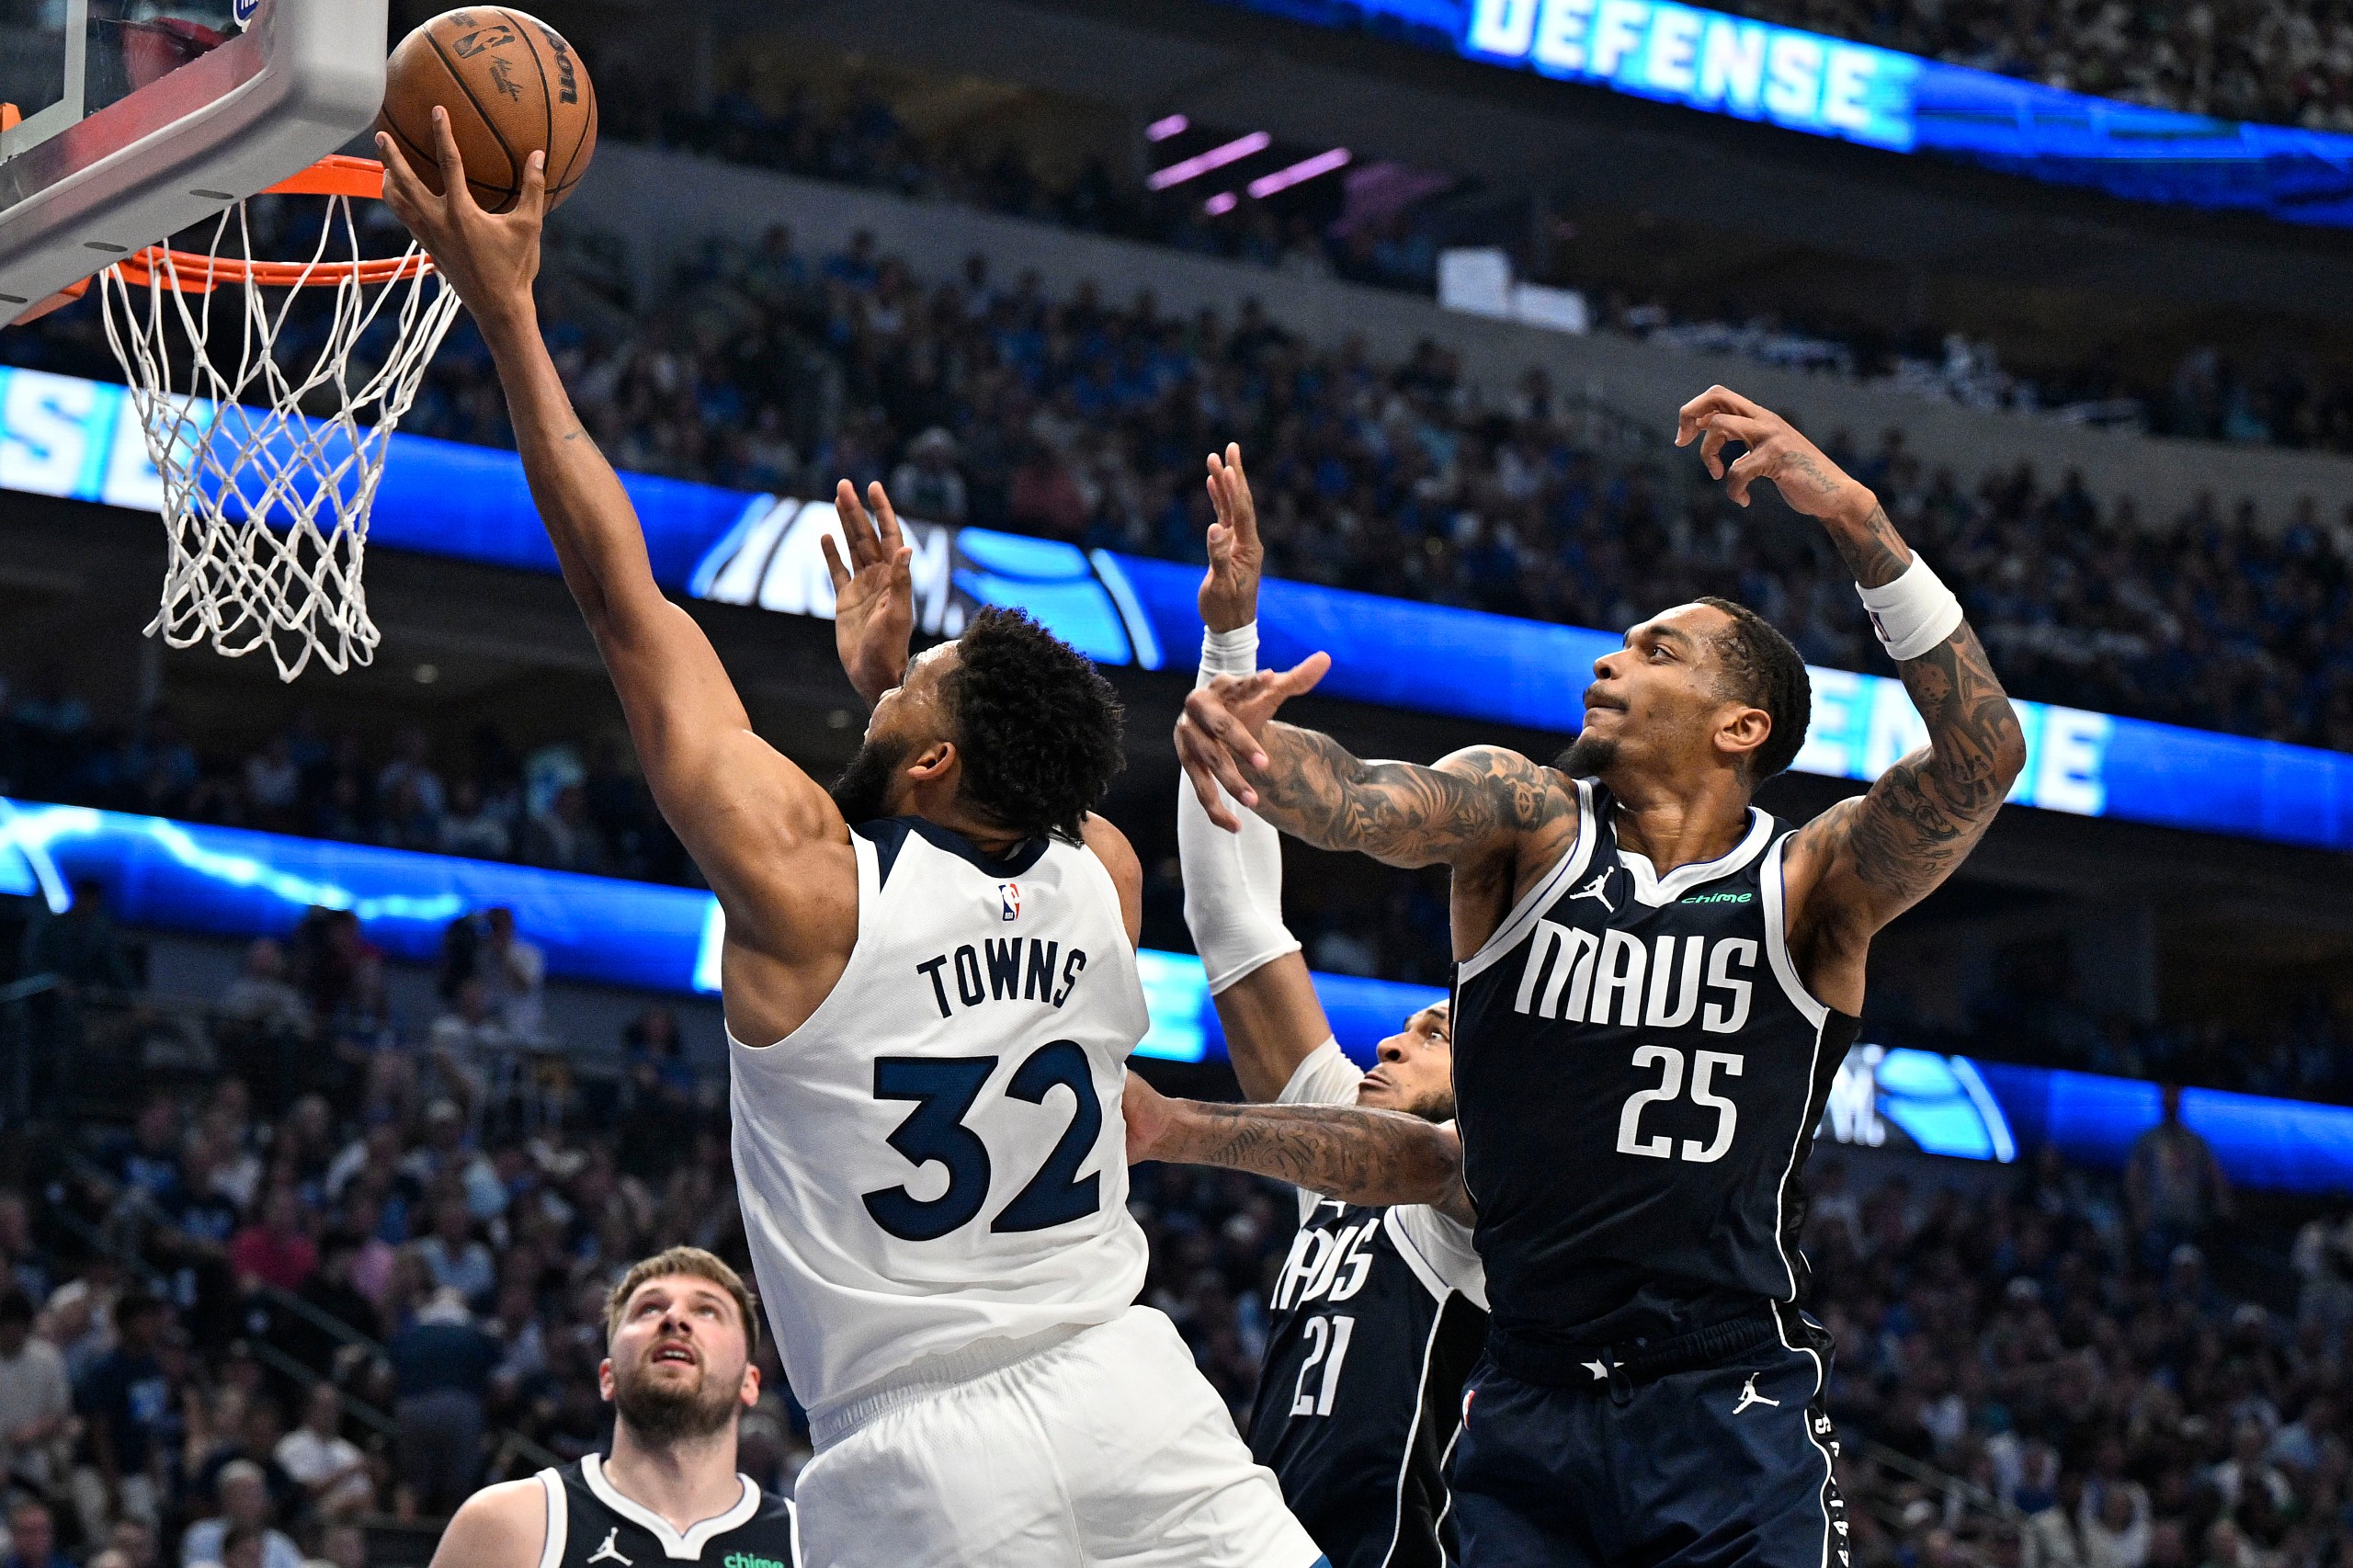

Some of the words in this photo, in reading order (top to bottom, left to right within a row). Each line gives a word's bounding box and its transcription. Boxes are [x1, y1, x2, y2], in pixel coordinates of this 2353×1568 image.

[1681, 892, 1753, 903] chime
[915, 937, 1087, 1018] TOWNS
[1514, 919, 1758, 1034] MAVS
[861, 1039, 1102, 1242] 32
[1617, 1045, 1745, 1163] 25
[1289, 1315, 1356, 1417] 21
